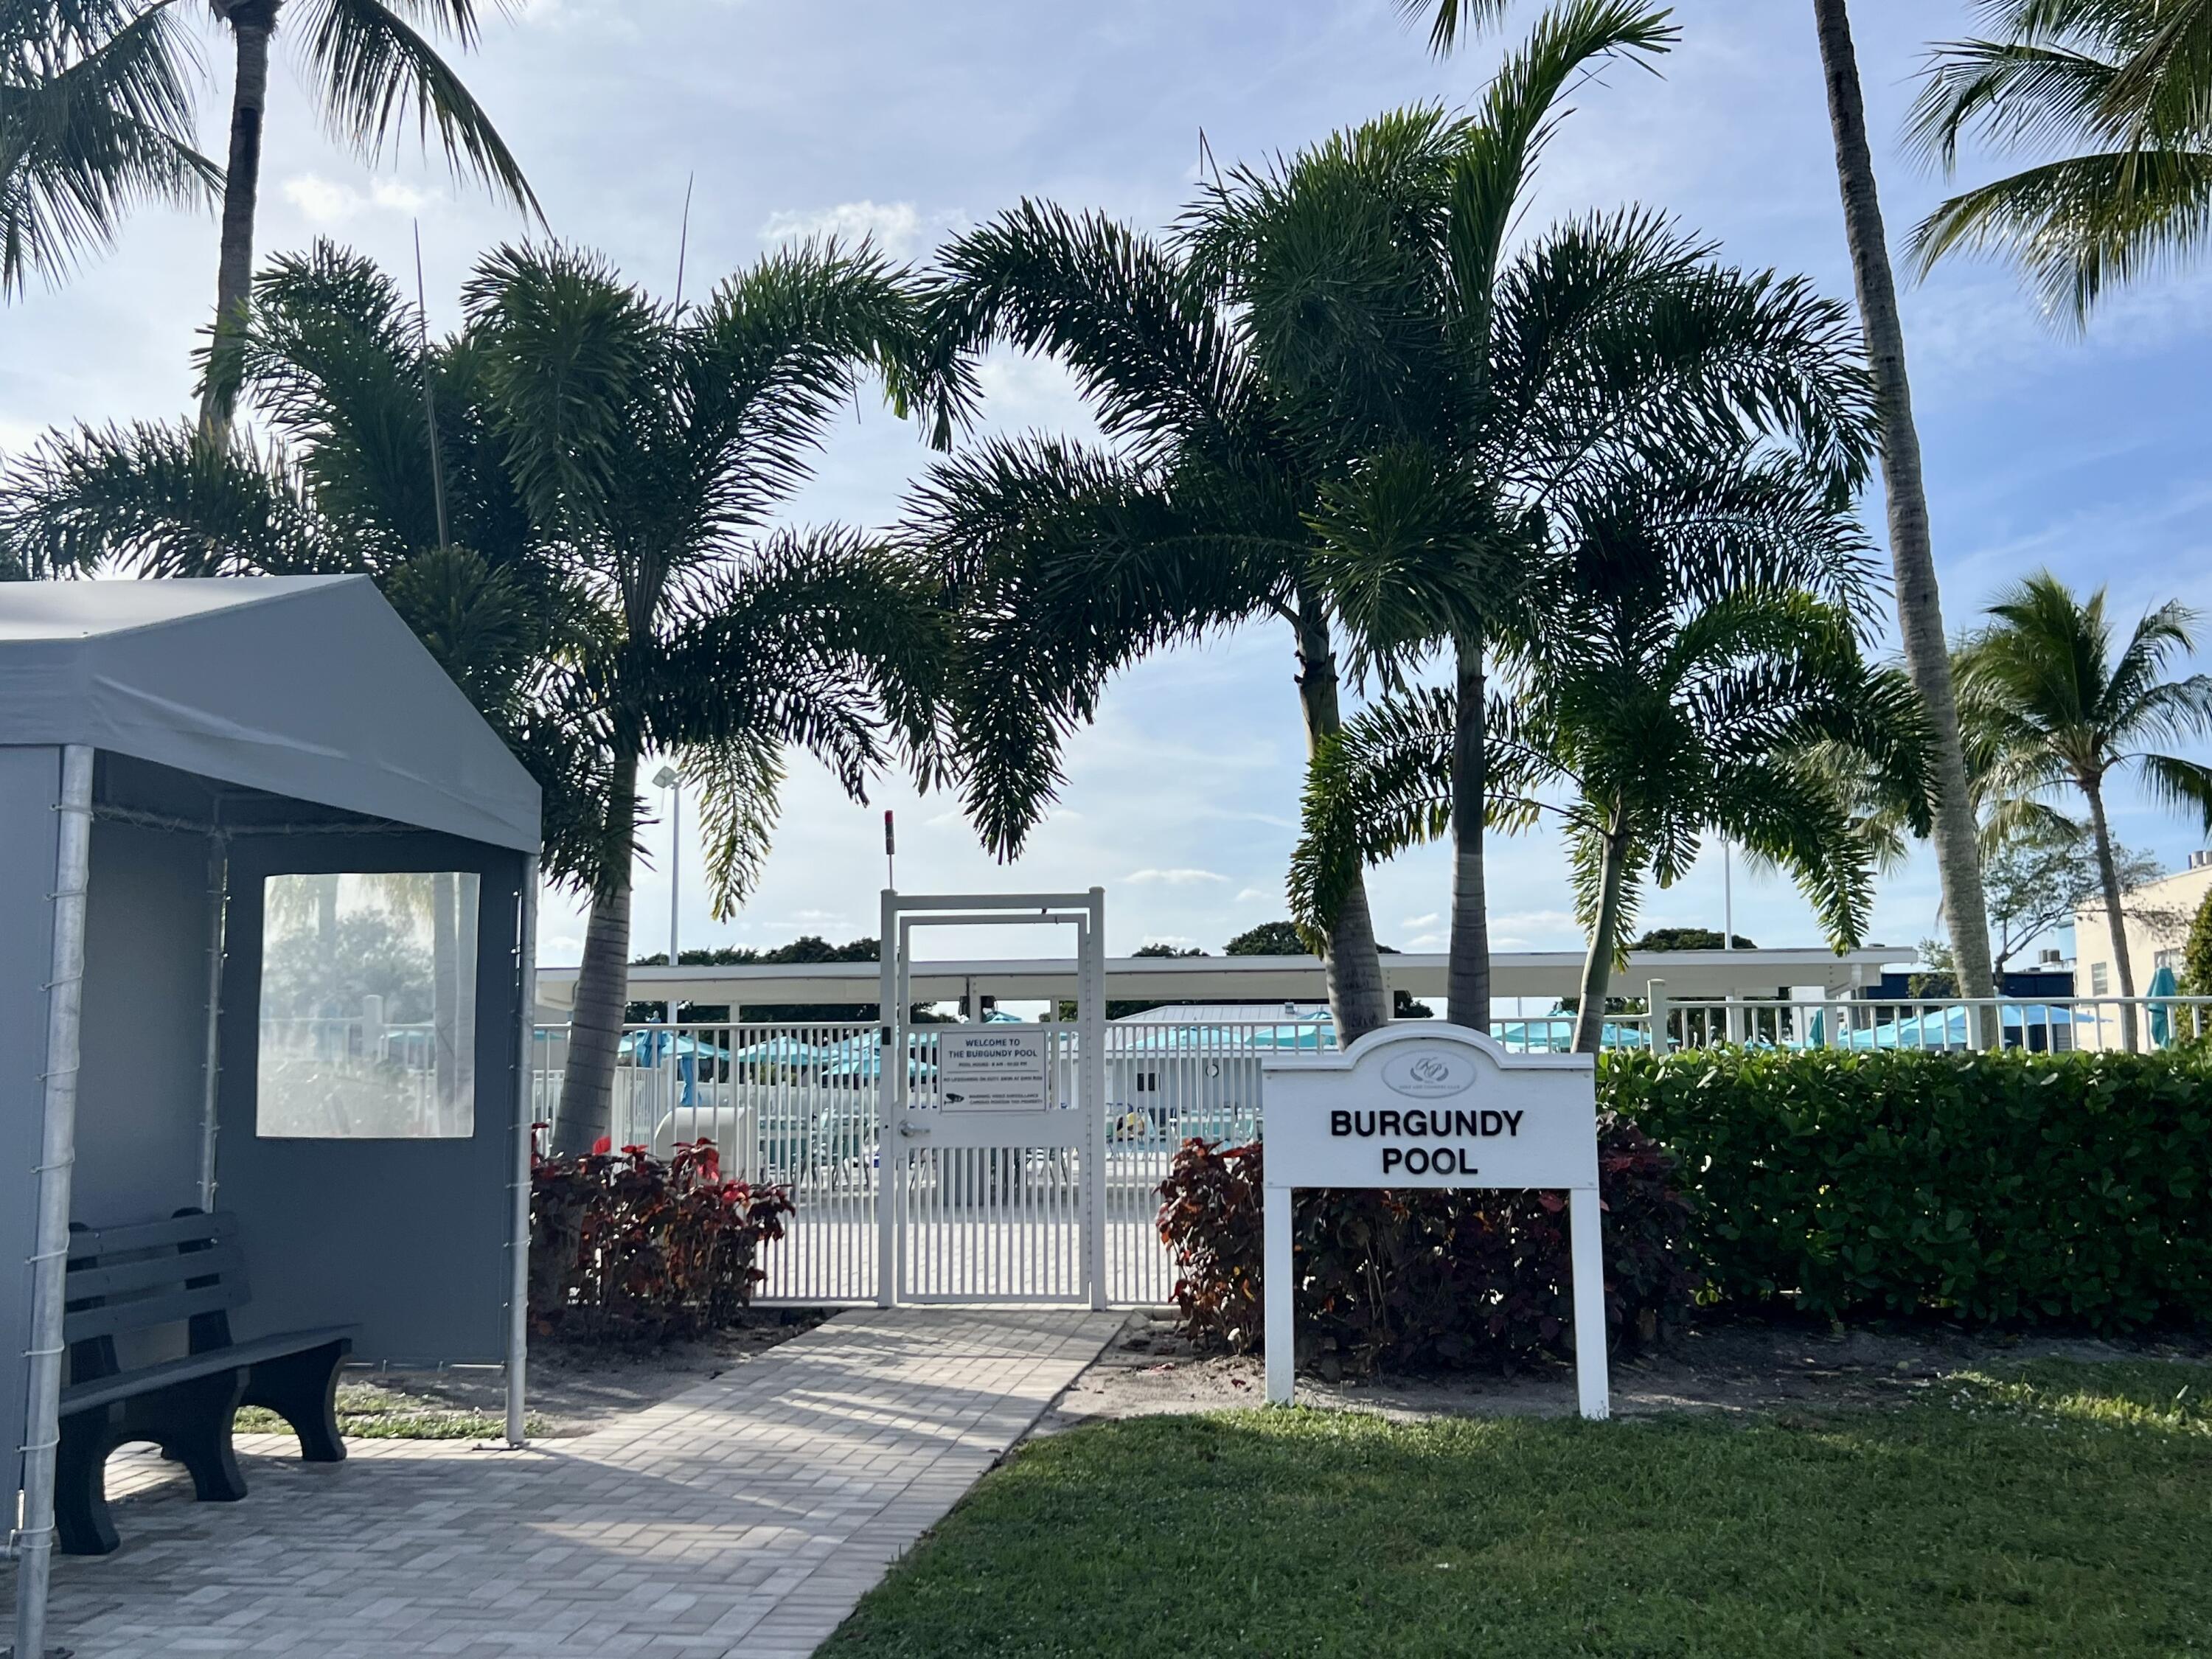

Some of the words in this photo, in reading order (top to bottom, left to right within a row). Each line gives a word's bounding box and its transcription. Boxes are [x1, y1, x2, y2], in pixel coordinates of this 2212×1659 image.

[965, 1038, 1007, 1047] WELCOME
[1009, 1038, 1020, 1046] TO
[949, 1050, 964, 1058] THE
[966, 1049, 1012, 1058] BURGUNDY
[1015, 1049, 1038, 1057] POOL
[1331, 1110, 1524, 1137] BURGUNDY
[1382, 1147, 1479, 1175] POOL
